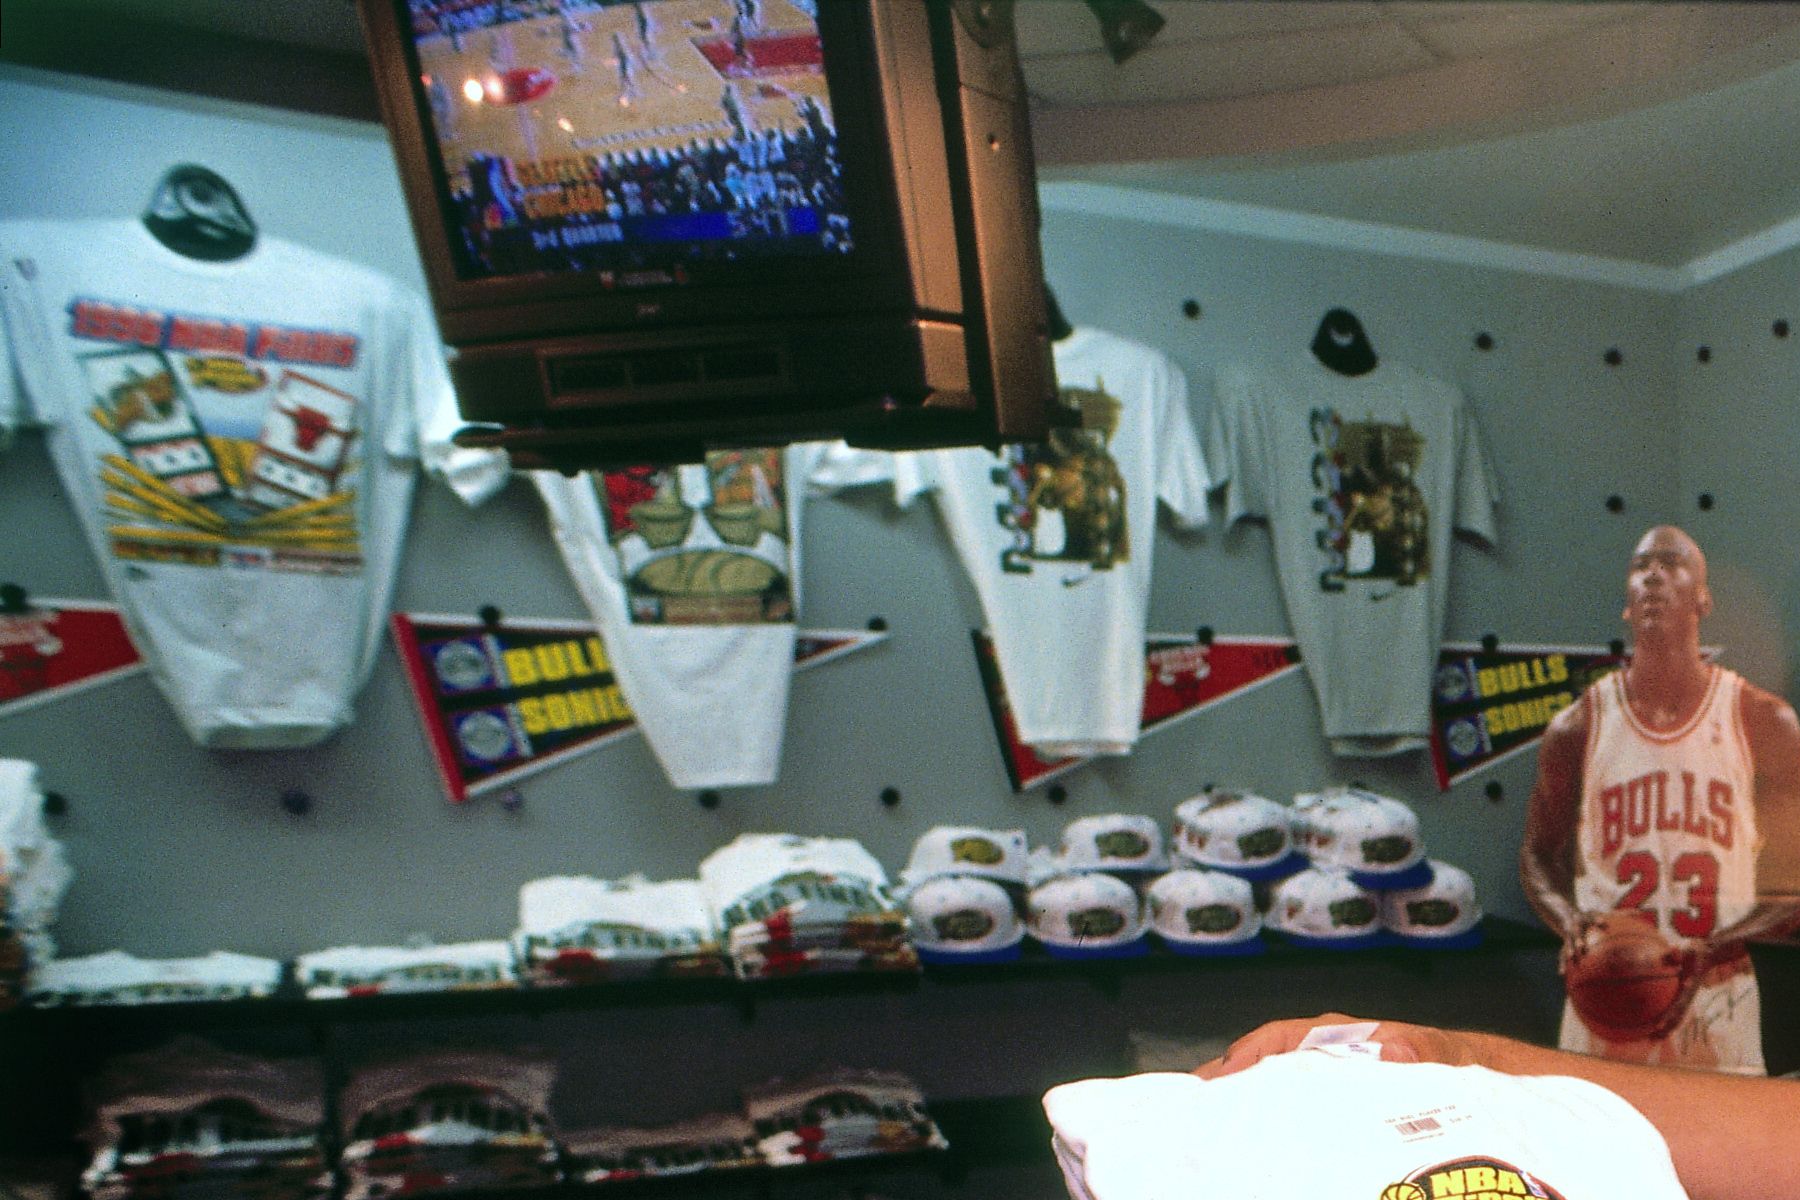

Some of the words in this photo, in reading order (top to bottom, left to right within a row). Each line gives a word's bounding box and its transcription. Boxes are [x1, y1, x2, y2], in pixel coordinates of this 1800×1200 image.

[1477, 654, 1568, 698] BULLS
[1600, 769, 1734, 859] BULLS
[1613, 851, 1720, 938] 23
[1429, 1166, 1527, 1196] NBA
